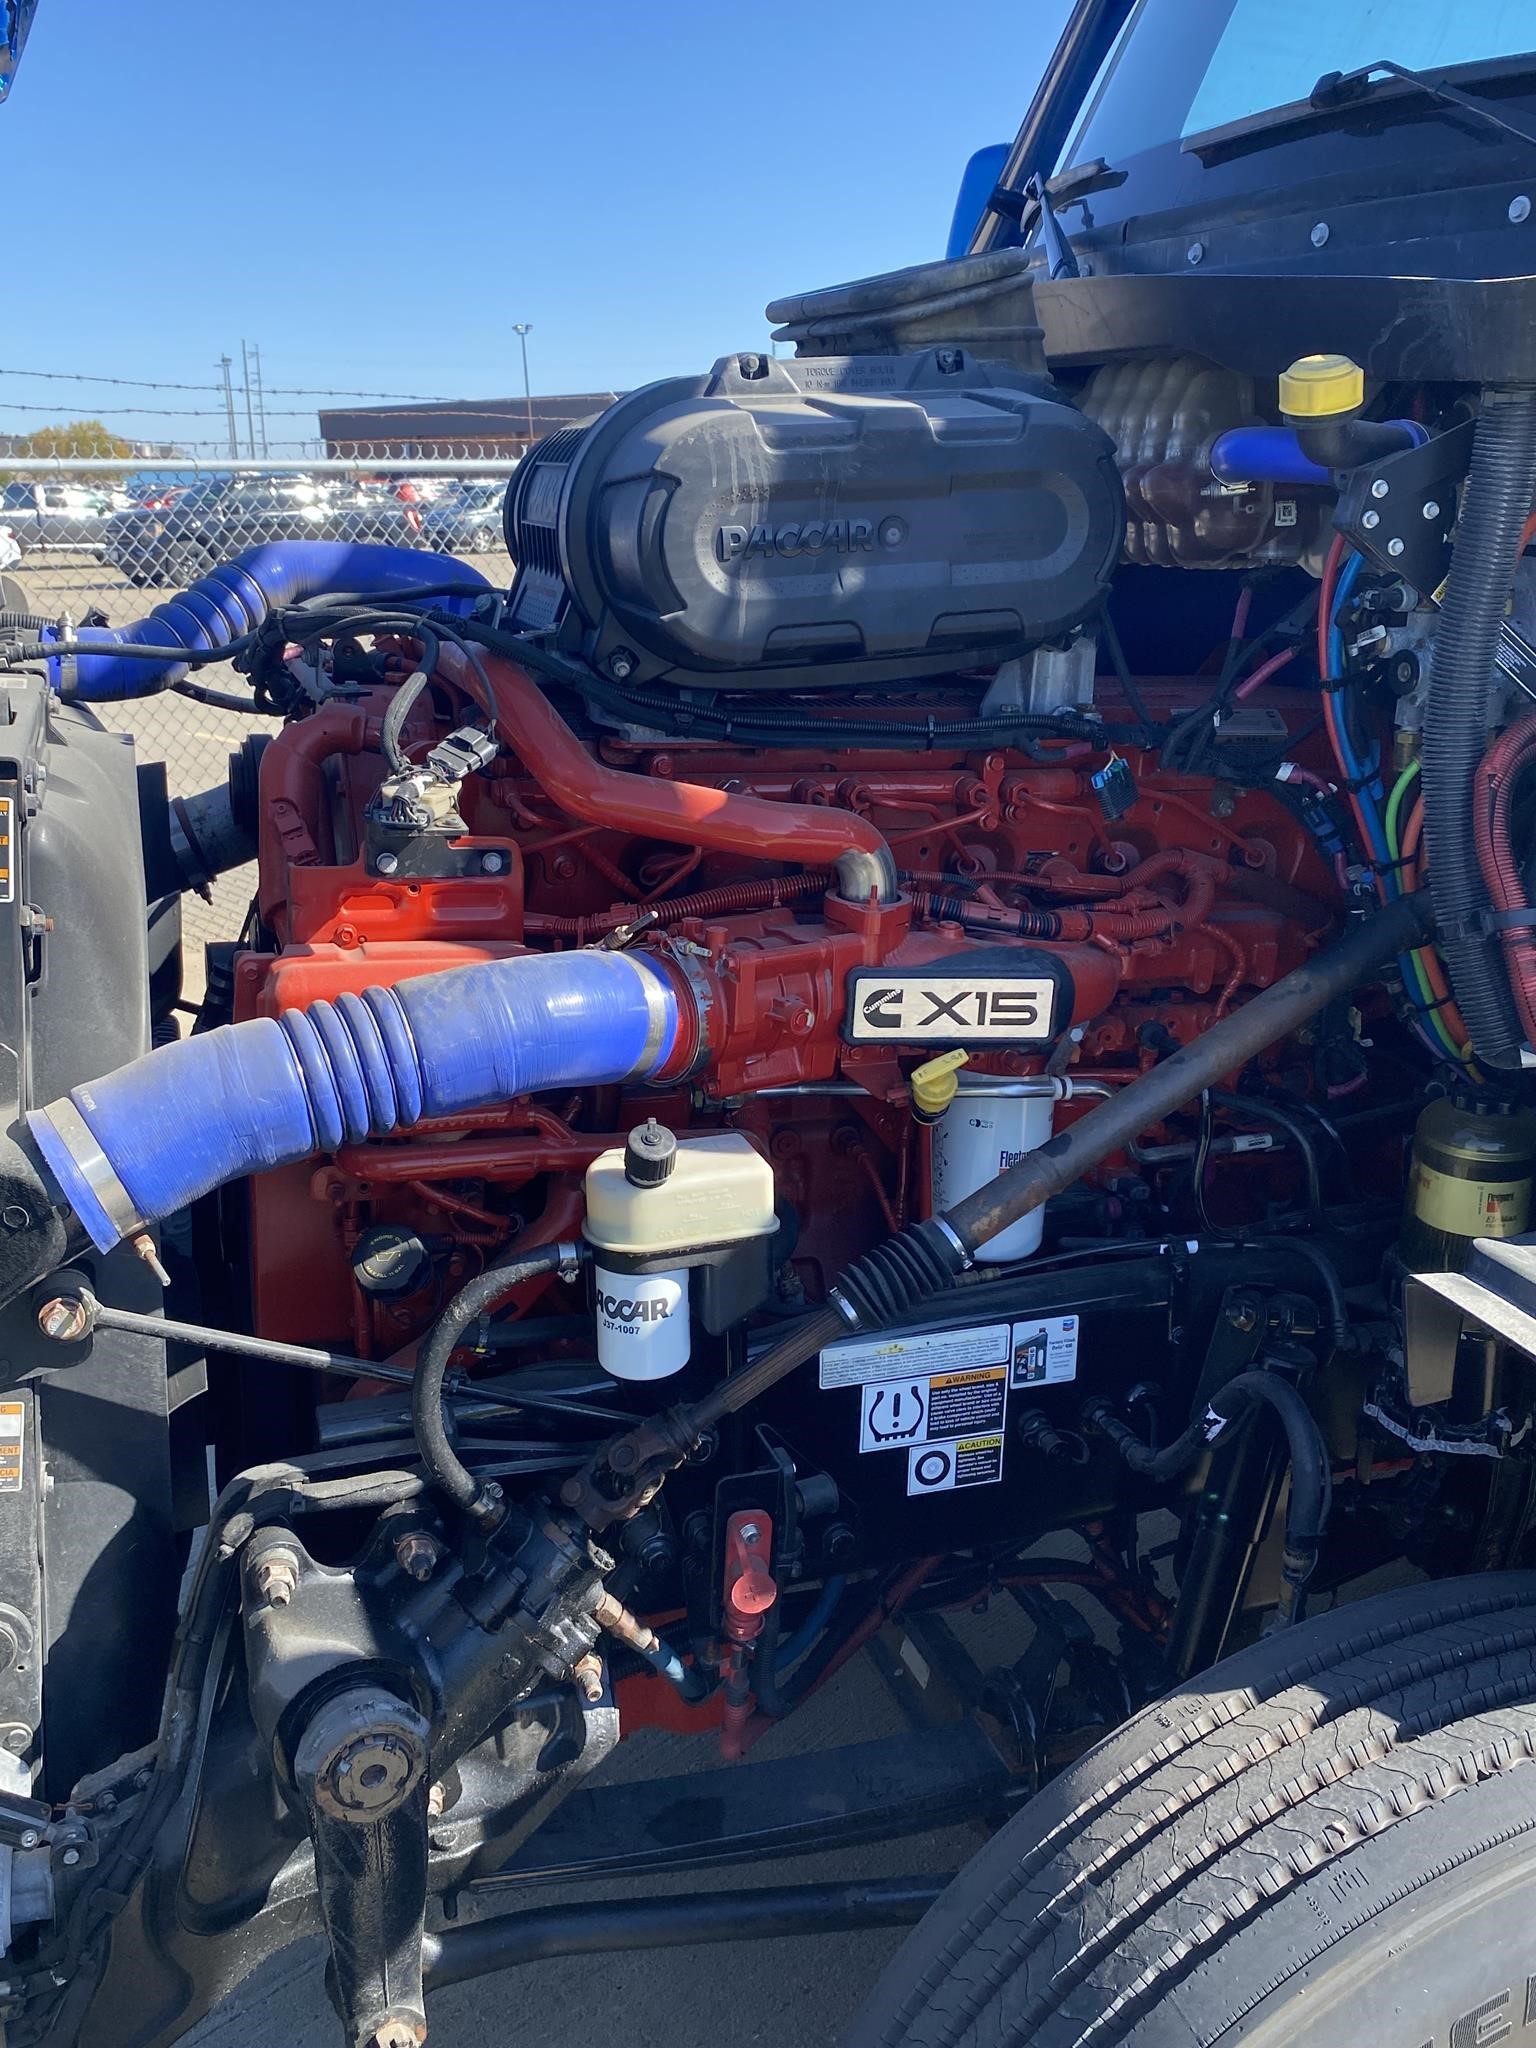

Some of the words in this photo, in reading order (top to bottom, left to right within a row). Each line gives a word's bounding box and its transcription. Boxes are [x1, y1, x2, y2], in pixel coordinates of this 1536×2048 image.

[717, 519, 872, 562] PACCAR
[863, 989, 902, 1014] Cummins
[916, 991, 1037, 1026] X15
[597, 1288, 671, 1323] ACCAR
[603, 1319, 641, 1335] J37-1007
[953, 1371, 991, 1383] WARNING
[965, 1438, 1000, 1449] CAUTION
